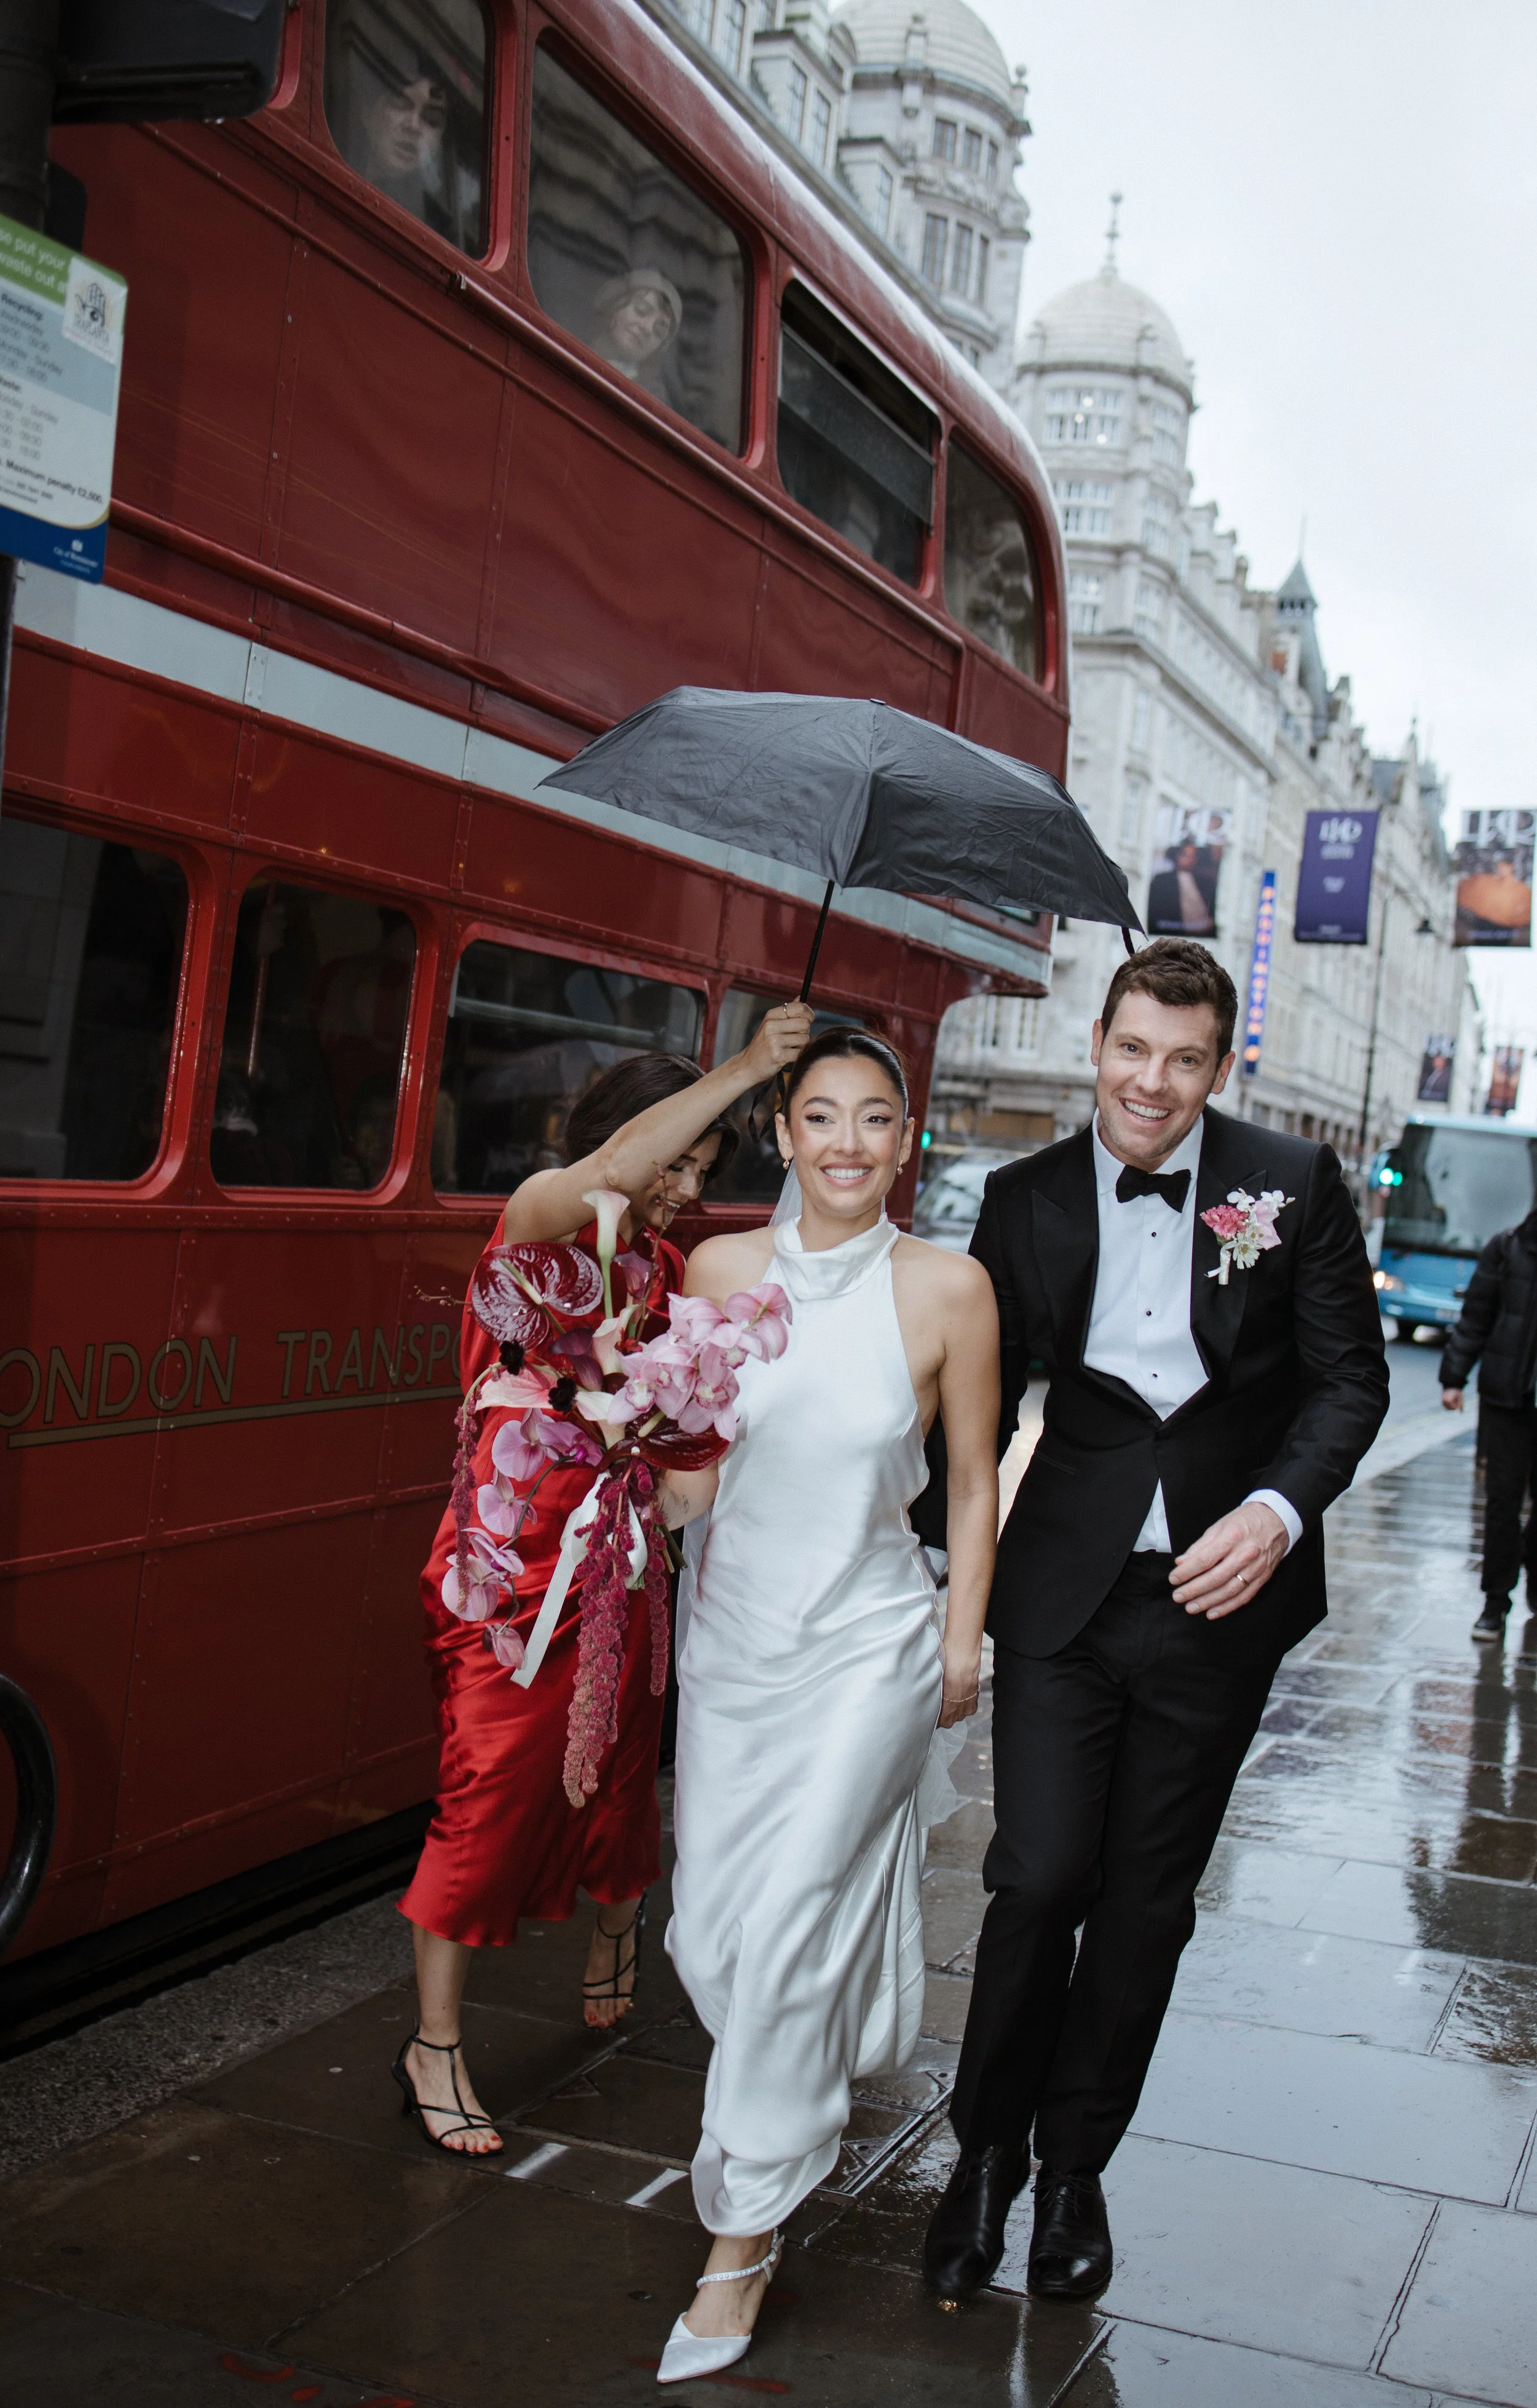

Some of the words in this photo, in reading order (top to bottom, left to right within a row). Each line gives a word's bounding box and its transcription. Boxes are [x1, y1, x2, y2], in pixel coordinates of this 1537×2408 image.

[15, 236, 38, 257] put
[39, 250, 66, 271] your
[34, 270, 56, 288] out
[6, 460, 45, 481] Maximum
[47, 477, 76, 495] penalty
